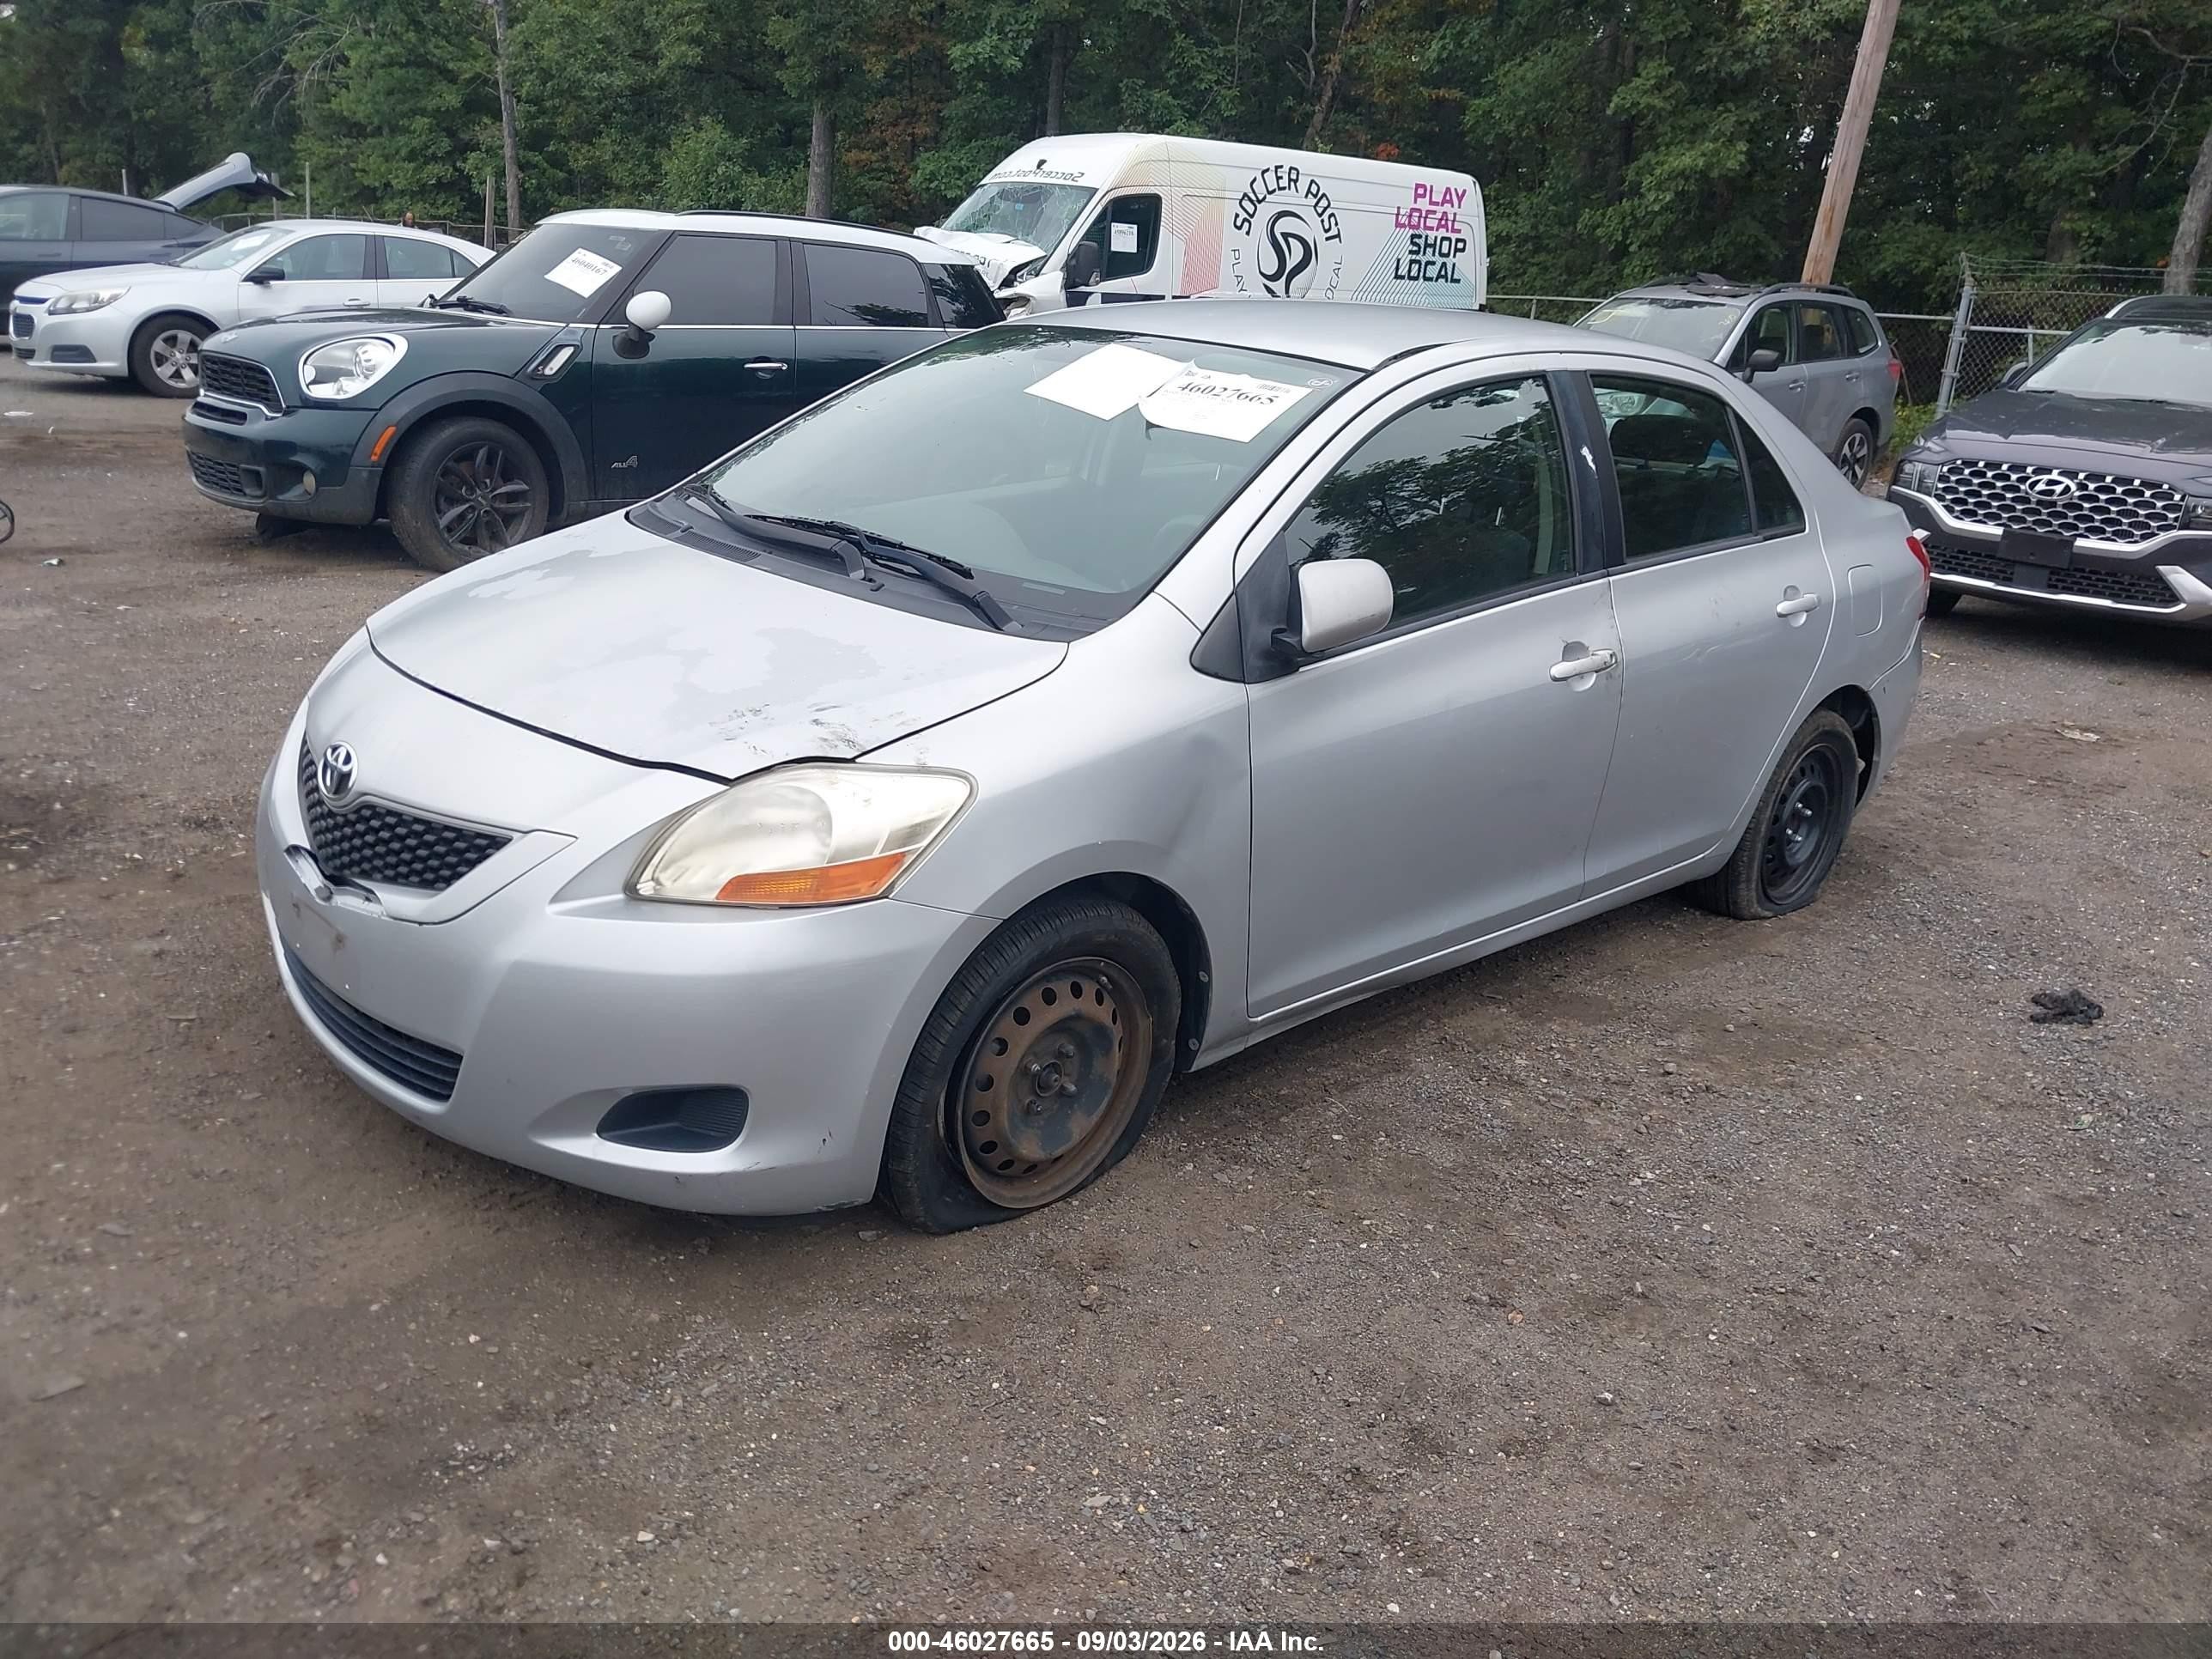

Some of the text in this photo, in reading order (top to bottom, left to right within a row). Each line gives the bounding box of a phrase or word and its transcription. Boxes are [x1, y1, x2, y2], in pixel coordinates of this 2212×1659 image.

[1233, 165, 1342, 244] SOCCER POST
[1413, 182, 1467, 209] PLAY
[1395, 206, 1462, 234] LOCAL
[1408, 233, 1467, 258] SHOP
[1231, 248, 1248, 294] PLAY
[1324, 254, 1343, 301] OCAL
[1393, 258, 1462, 284] LOCAL
[1177, 381, 1279, 405] 46027665
